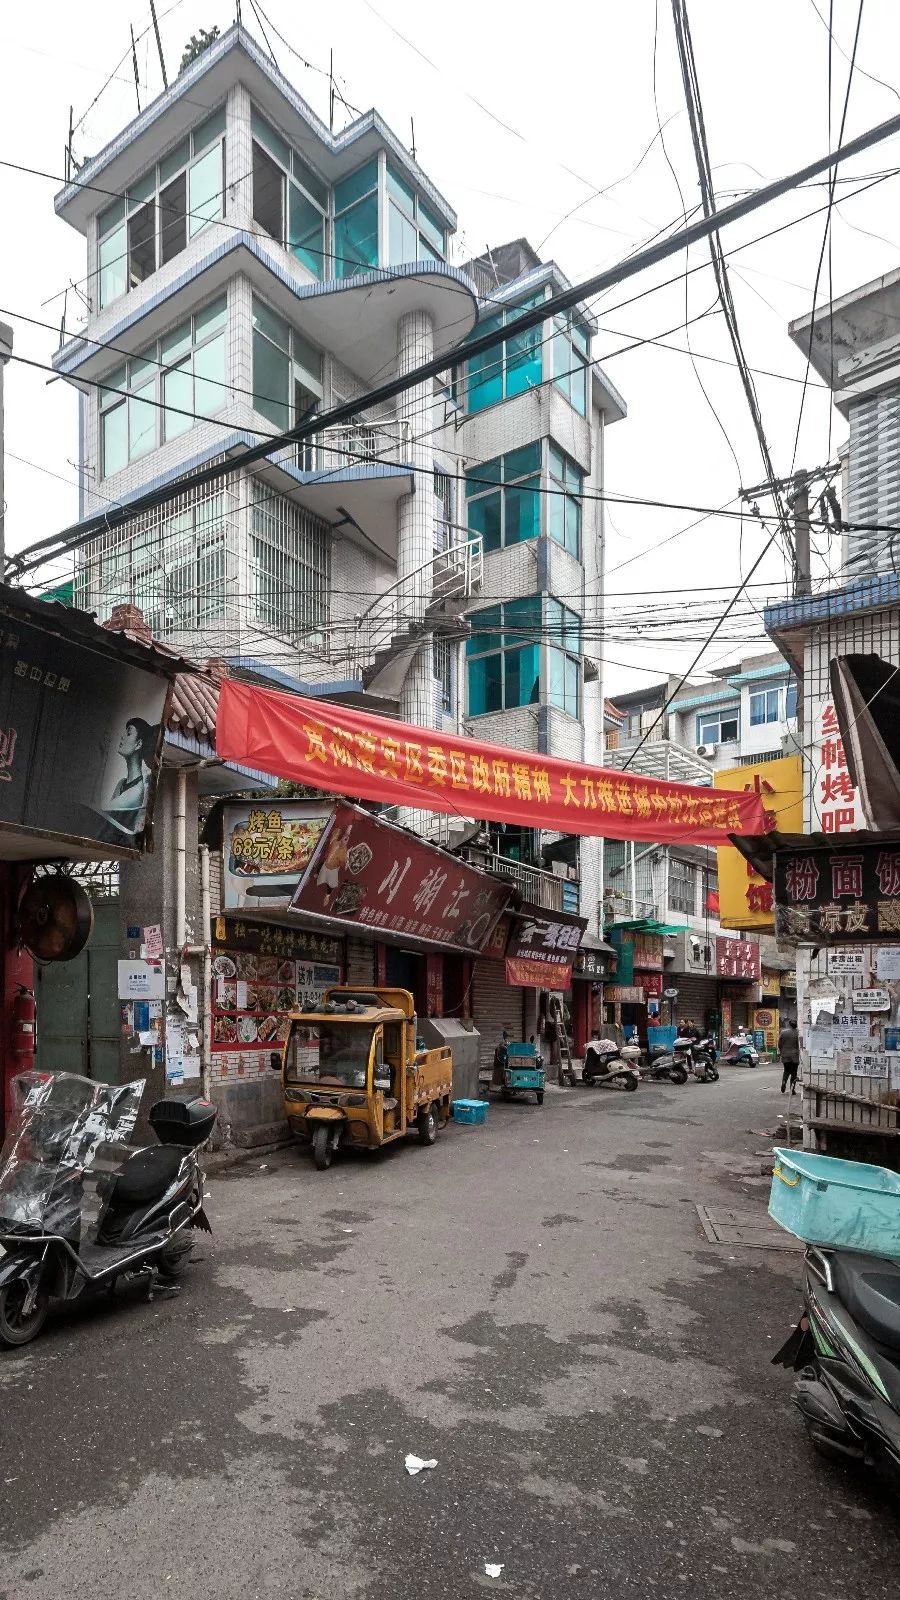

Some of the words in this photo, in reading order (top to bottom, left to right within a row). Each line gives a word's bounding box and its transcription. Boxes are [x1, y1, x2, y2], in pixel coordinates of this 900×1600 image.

[248, 810, 282, 832] 烤鱼
[233, 836, 294, 860] 68元/条
[786, 851, 900, 900] 粉面饭
[832, 1016, 867, 1025] 饭店转让
